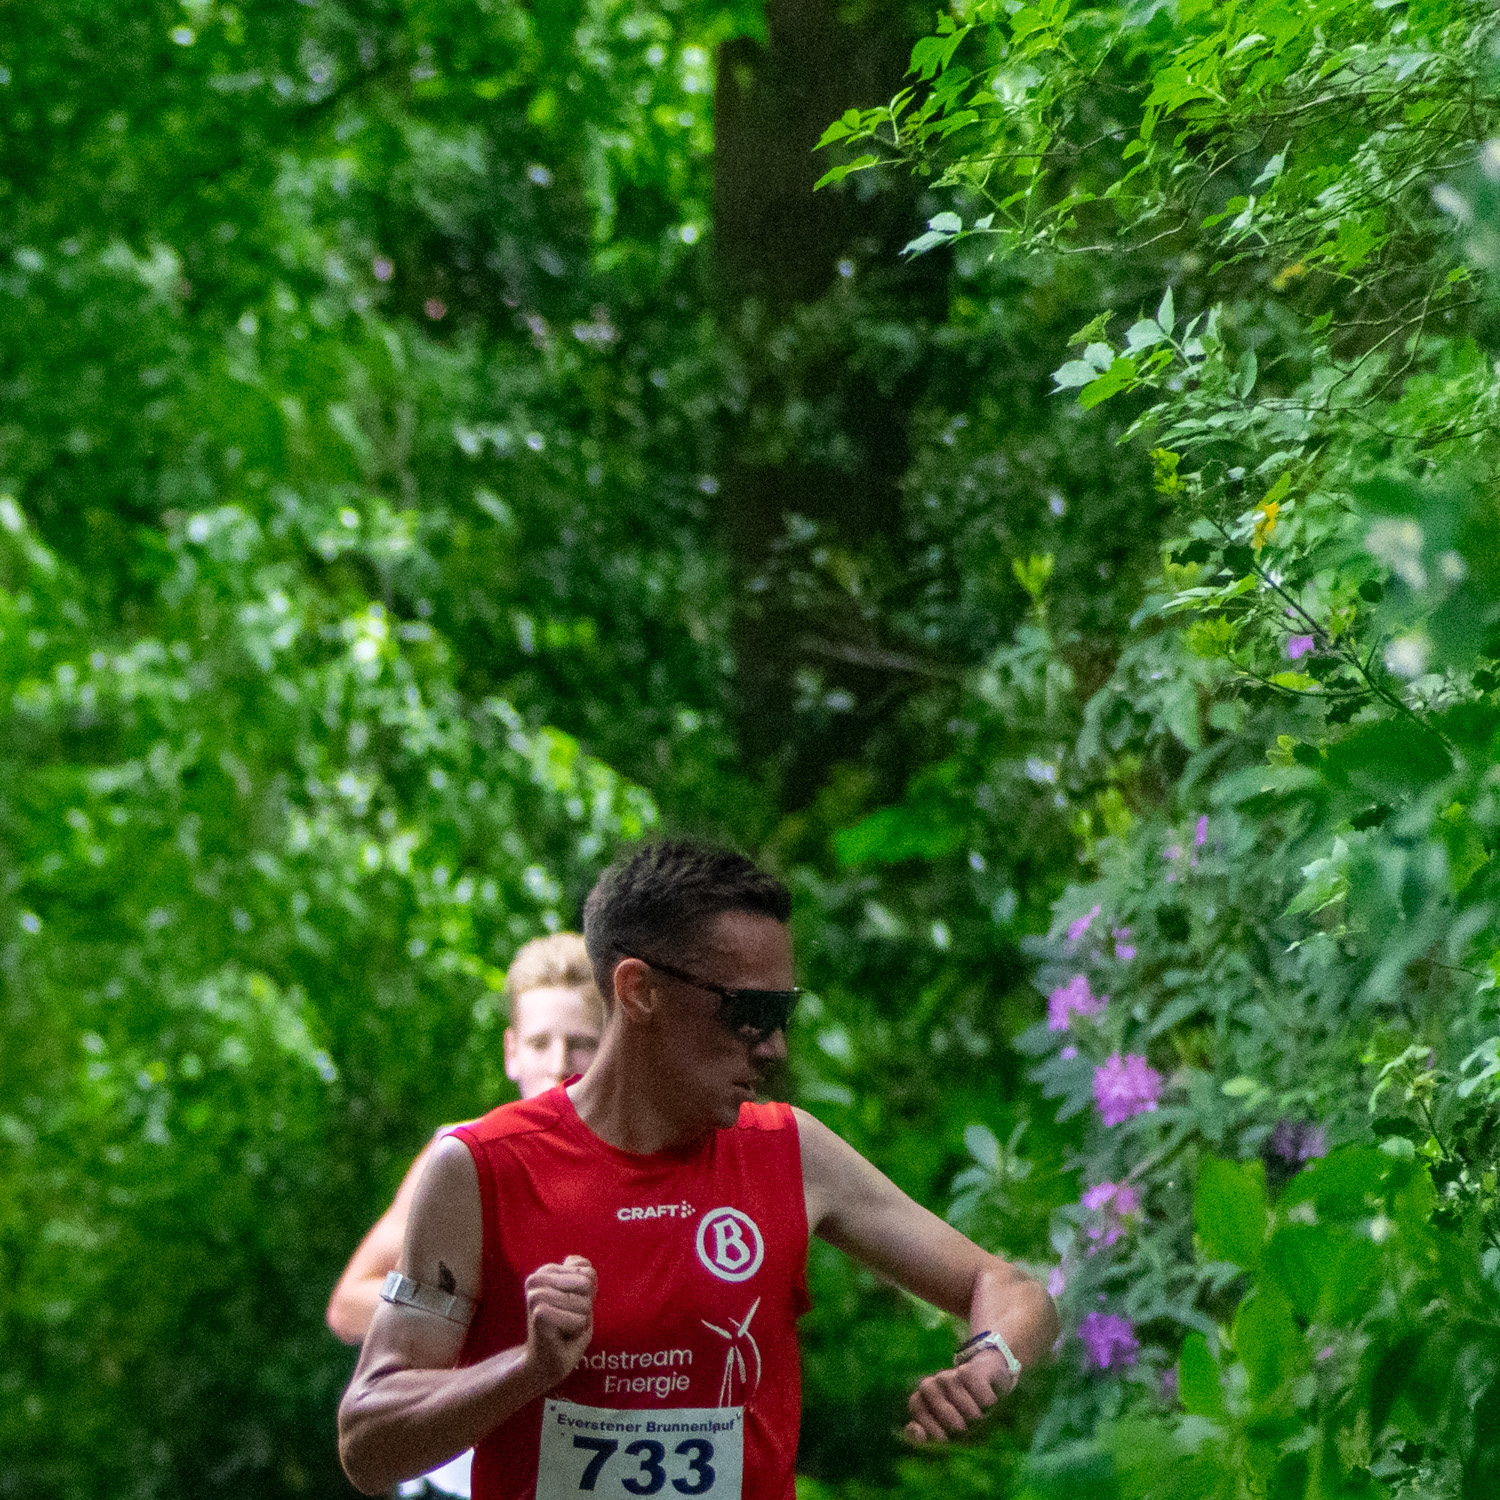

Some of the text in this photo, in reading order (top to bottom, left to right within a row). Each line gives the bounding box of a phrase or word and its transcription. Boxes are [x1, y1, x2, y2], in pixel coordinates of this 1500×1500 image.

[616, 1203, 679, 1221] CRAFT
[573, 1349, 693, 1371] ndstream
[604, 1371, 690, 1399] Energie
[557, 1412, 735, 1434] Everstener Brunnenlauf
[573, 1435, 716, 1496] 733
